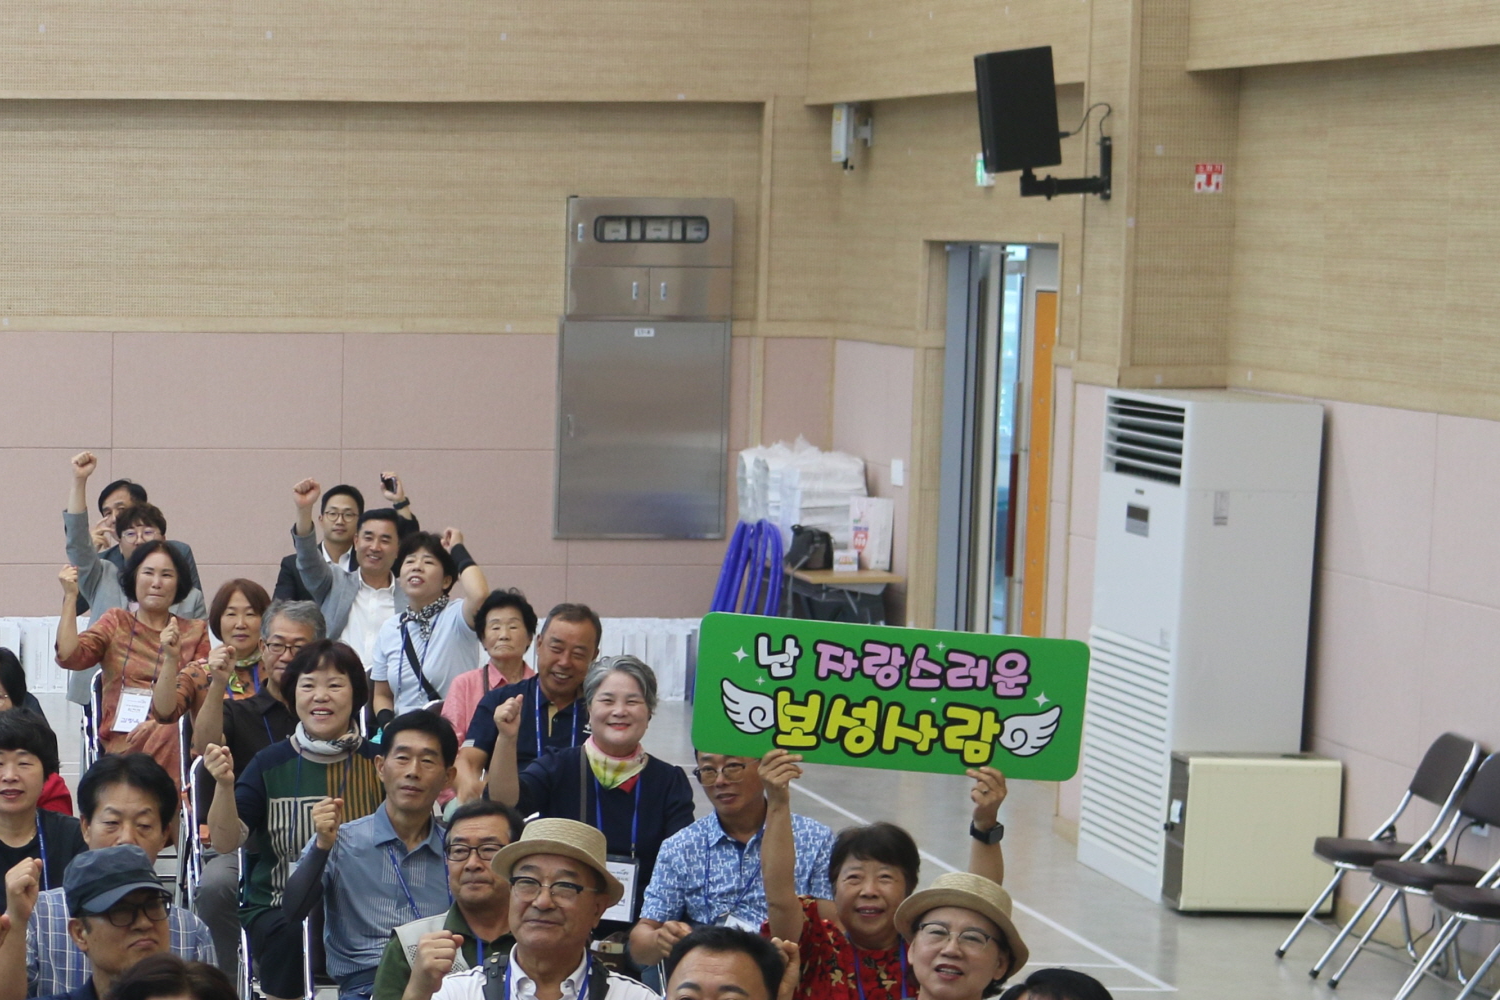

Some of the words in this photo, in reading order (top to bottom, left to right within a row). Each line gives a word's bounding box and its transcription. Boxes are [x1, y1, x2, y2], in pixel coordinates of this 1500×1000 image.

[755, 633, 801, 679] 난
[814, 639, 1030, 698] 자랑스러운
[773, 687, 1003, 766] 보성사람
